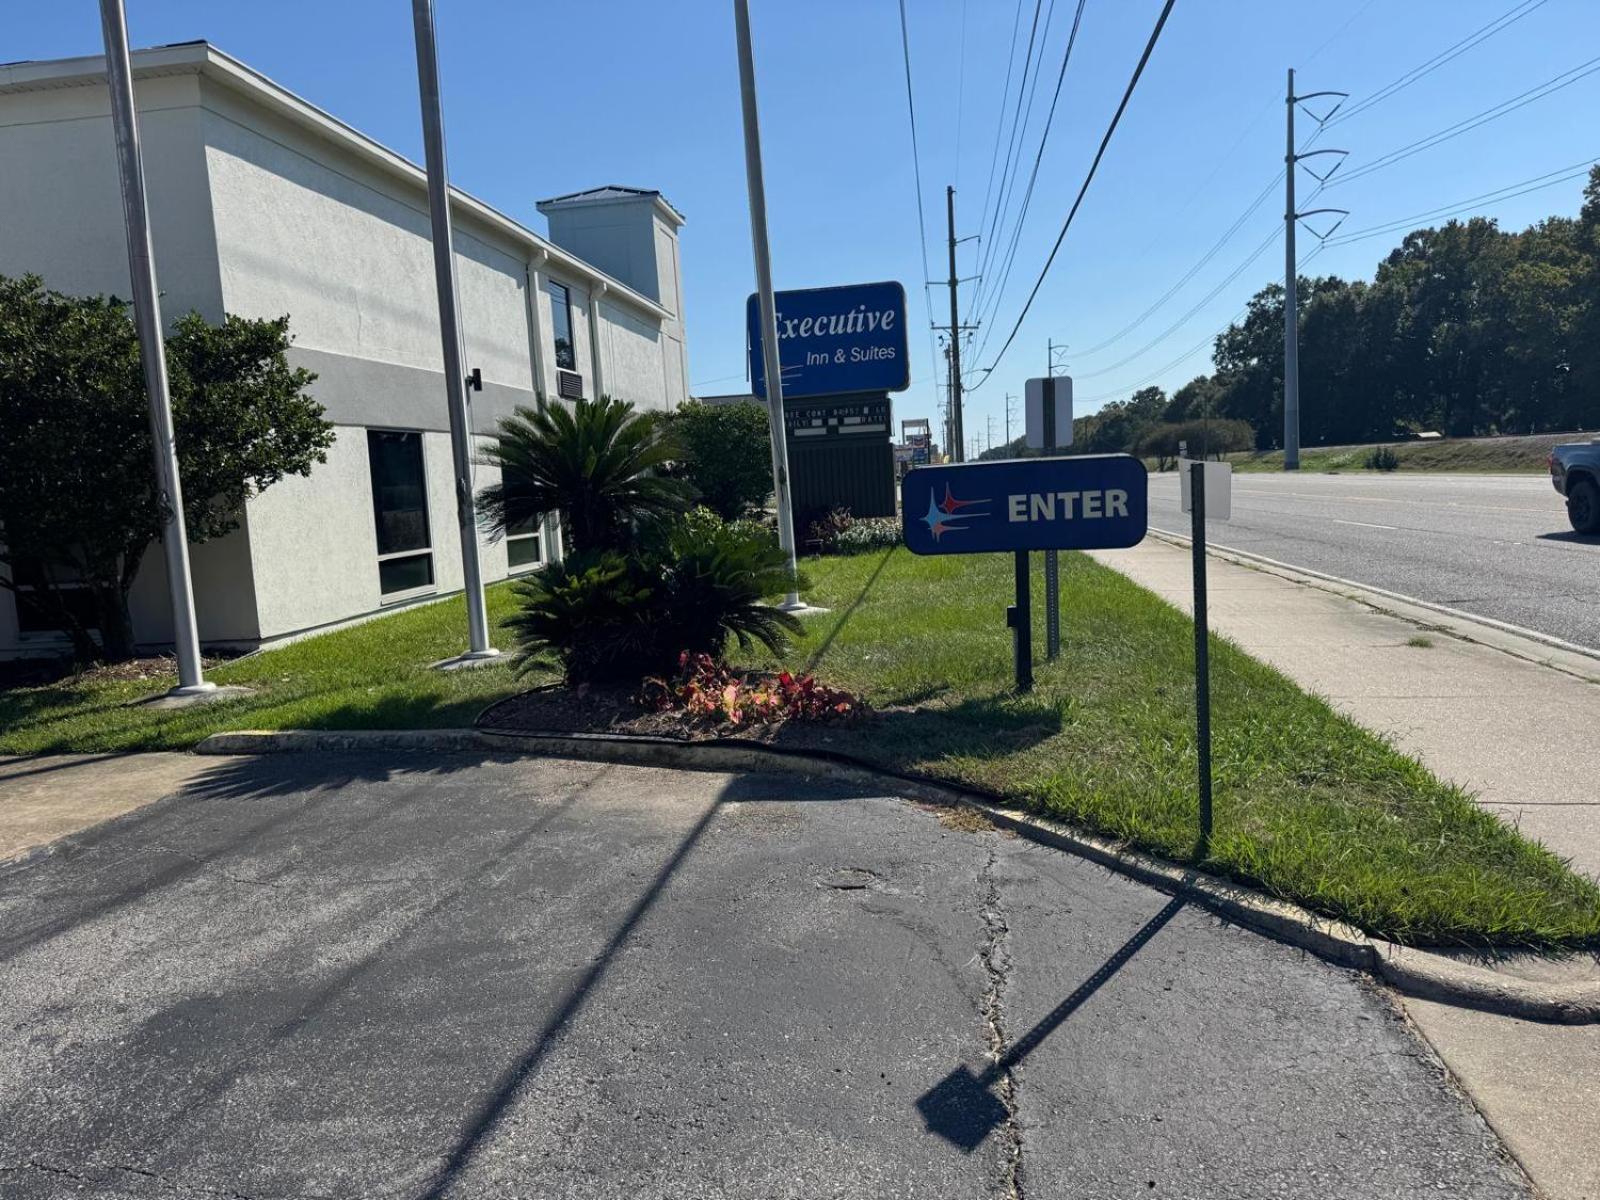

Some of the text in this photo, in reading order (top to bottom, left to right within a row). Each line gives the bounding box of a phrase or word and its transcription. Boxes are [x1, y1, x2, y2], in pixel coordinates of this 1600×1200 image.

[806, 346, 896, 366] Inn & Suites
[1008, 489, 1129, 522] ENTER
